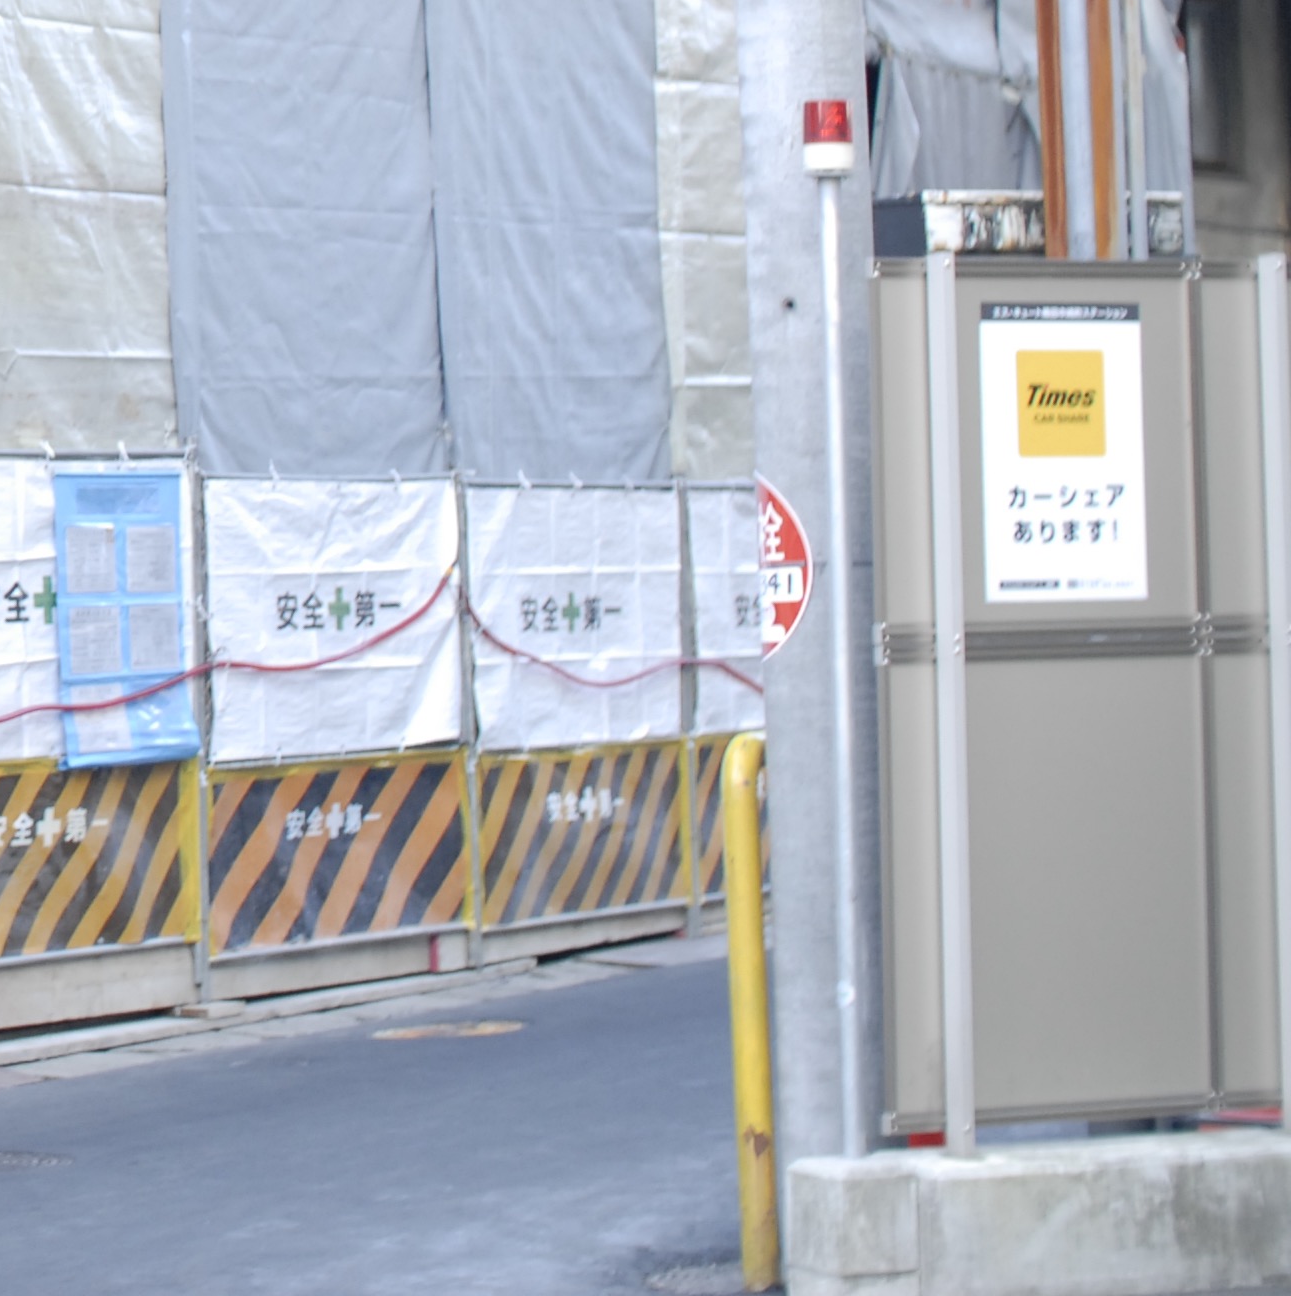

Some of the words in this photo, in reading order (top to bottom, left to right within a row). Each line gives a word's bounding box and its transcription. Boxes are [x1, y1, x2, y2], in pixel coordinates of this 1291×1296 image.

[1025, 383, 1097, 408] Times
[1008, 483, 1125, 510] カーシェア
